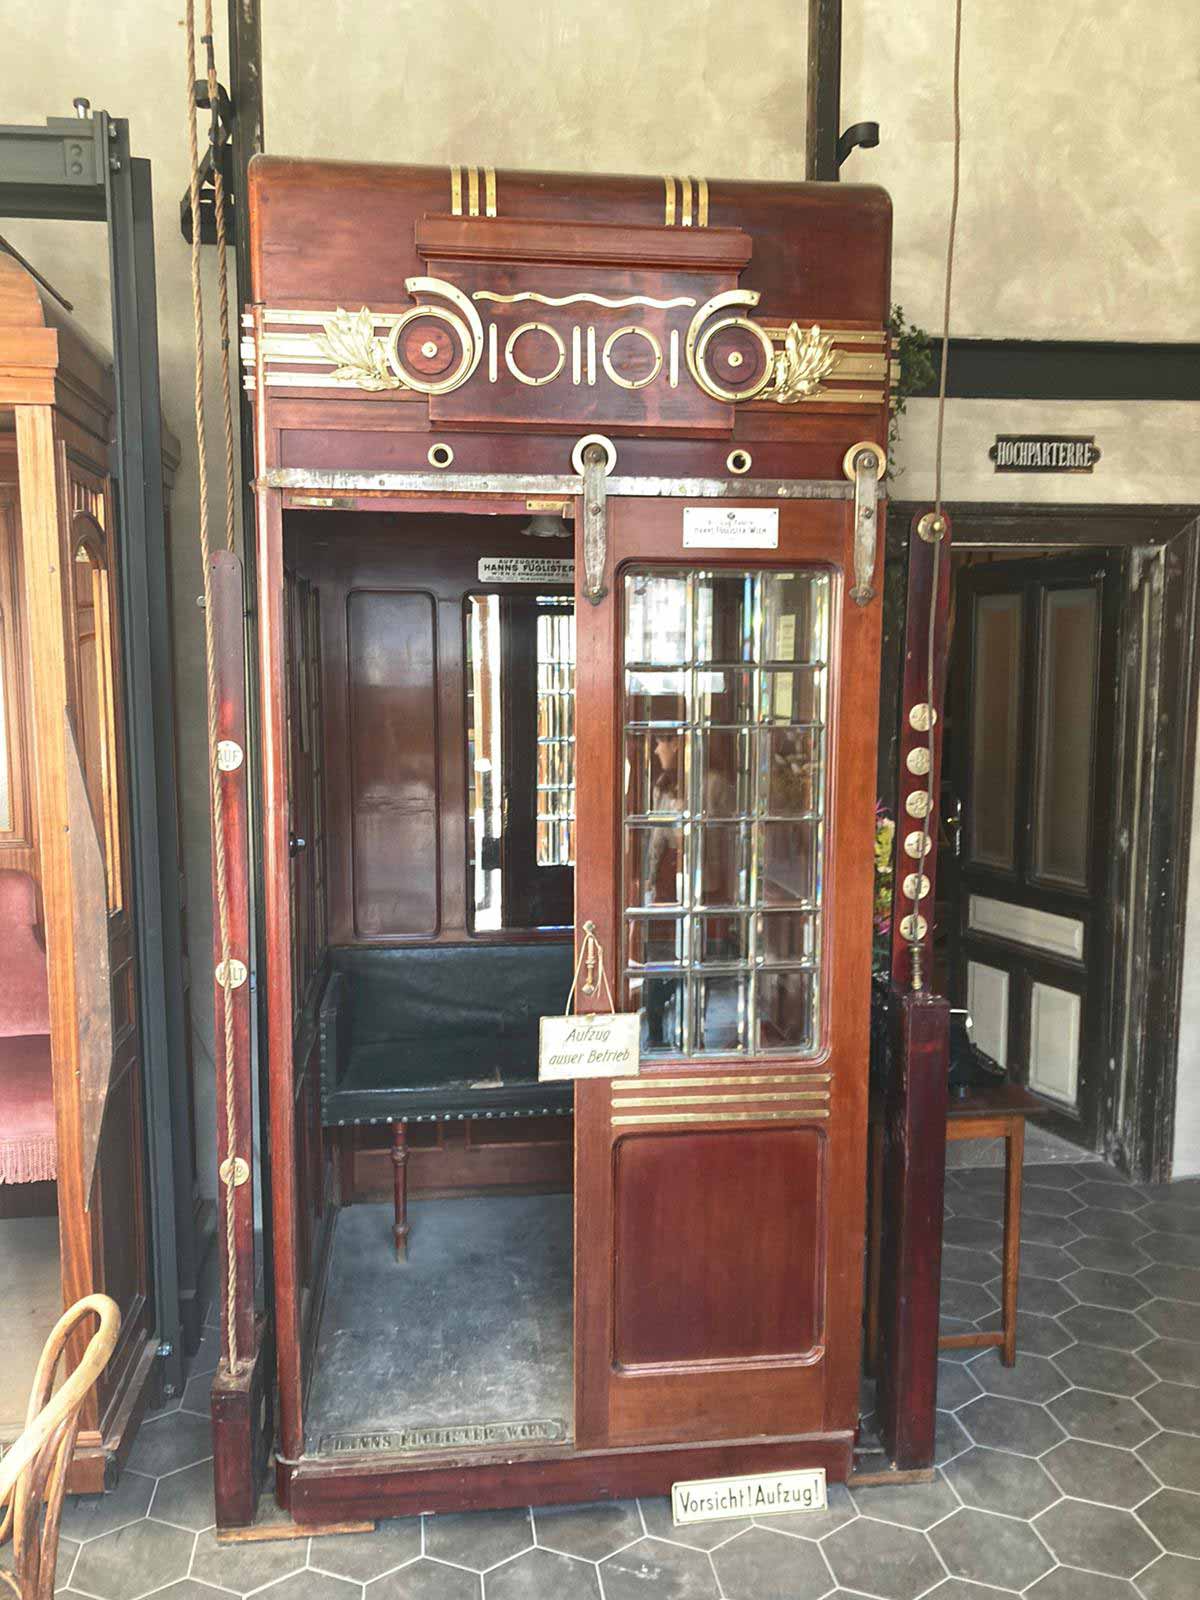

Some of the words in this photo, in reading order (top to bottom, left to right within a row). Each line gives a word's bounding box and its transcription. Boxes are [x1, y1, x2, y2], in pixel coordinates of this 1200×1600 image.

[996, 441, 1093, 467] HOCHPARTERRE
[483, 564, 519, 572] HANNS
[219, 967, 244, 981] HLT
[565, 1026, 611, 1042] Aufzug
[548, 1052, 584, 1065] ausser
[587, 1048, 630, 1063] Betrieb
